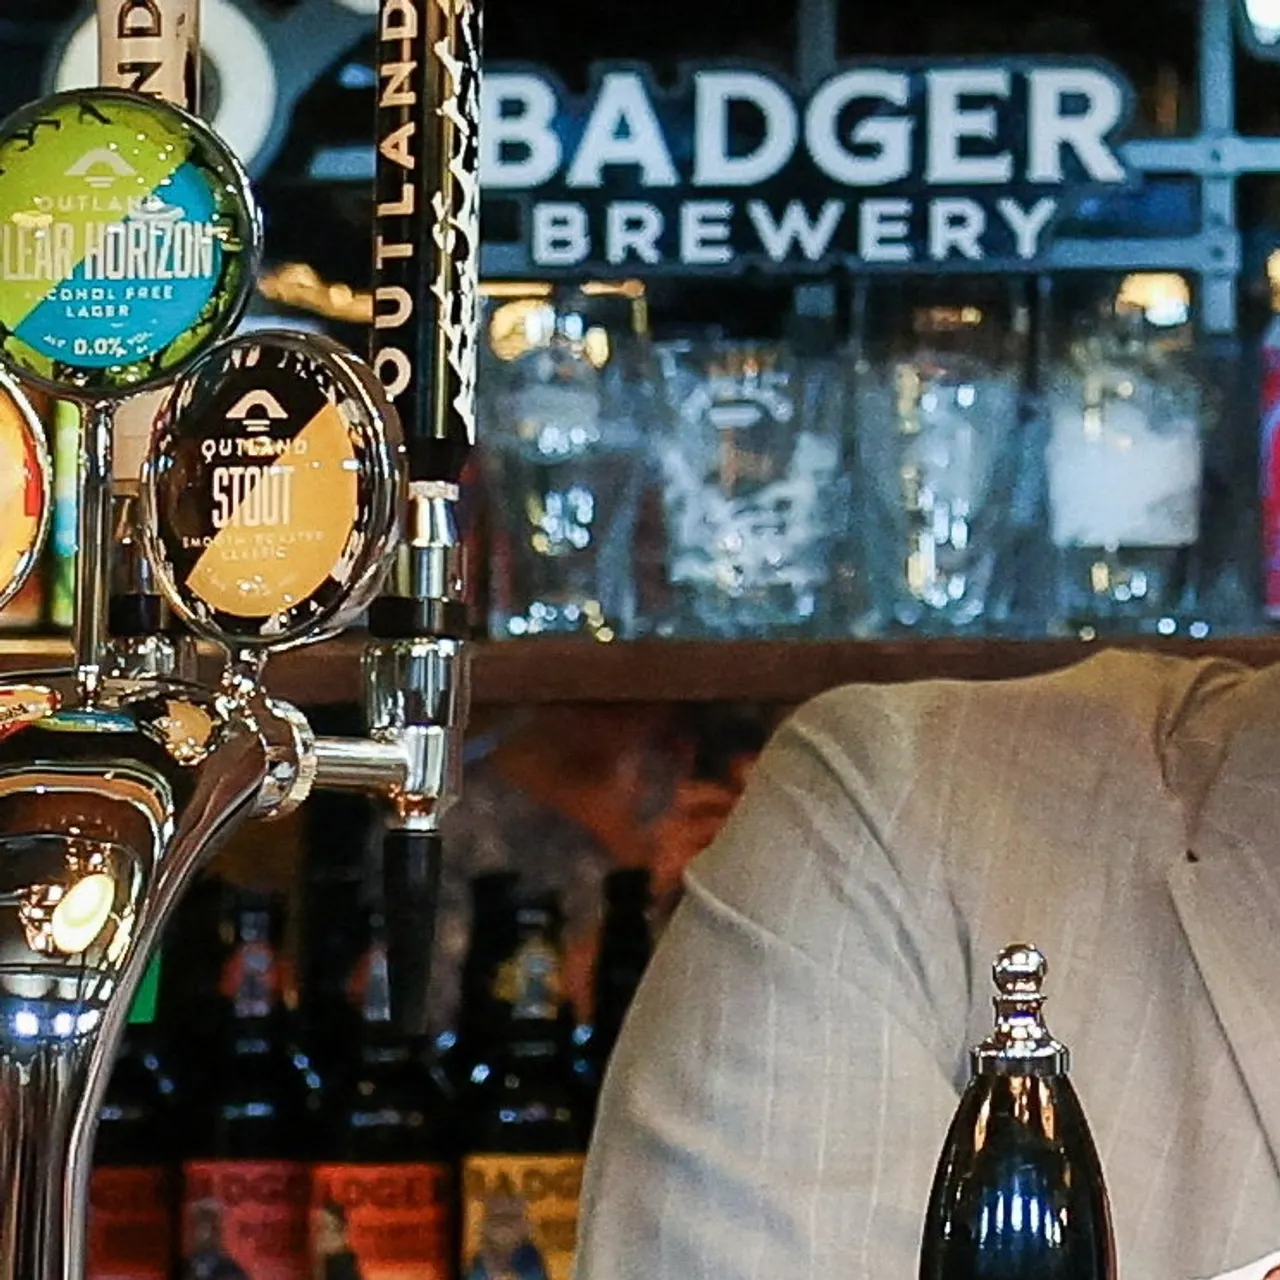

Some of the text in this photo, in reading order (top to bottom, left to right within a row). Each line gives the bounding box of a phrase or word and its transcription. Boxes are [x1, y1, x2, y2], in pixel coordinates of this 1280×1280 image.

[481, 70, 1127, 188] BADGER
[374, 0, 418, 397] OUTLAND
[2, 220, 214, 281] LEAR HORIZON
[533, 199, 1063, 266] BREWERY
[66, 304, 130, 319] LAGER
[125, 285, 175, 300] FREE
[73, 337, 124, 357] 0.0%
[201, 437, 308, 457] OUTLAND
[212, 465, 295, 529] STOUT
